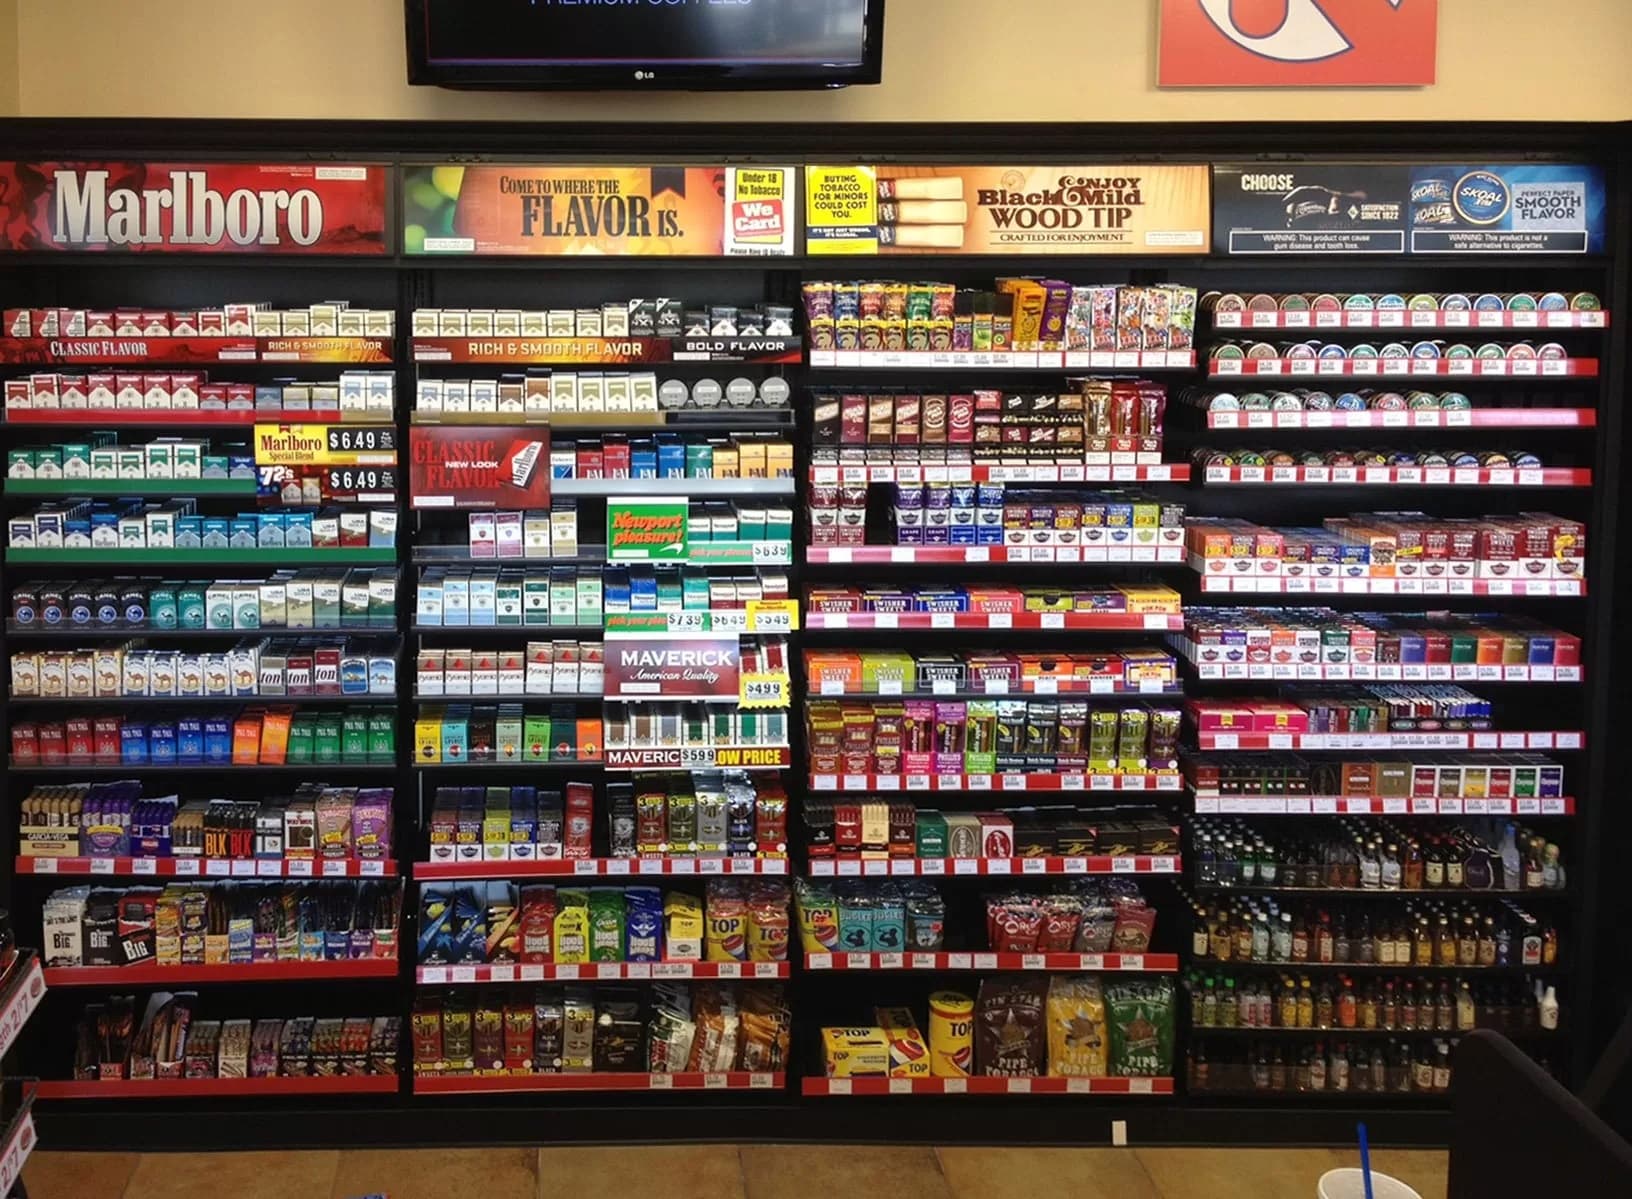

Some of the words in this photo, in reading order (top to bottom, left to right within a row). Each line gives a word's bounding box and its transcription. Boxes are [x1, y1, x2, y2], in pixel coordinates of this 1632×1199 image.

[500, 176, 533, 194] COME
[537, 180, 550, 194] TO
[551, 180, 595, 194] WHERE
[596, 180, 620, 194] THE
[742, 172, 766, 183] Under
[824, 175, 857, 183] BUYING
[1241, 174, 1294, 191] CHOOSE
[738, 184, 748, 195] No
[750, 185, 780, 196] Tobacco
[820, 183, 861, 192] TOBACCO
[1460, 187, 1502, 203] SKOAL
[813, 192, 831, 201] FOR
[834, 191, 868, 200] MINORS
[977, 188, 1059, 206] Black
[1081, 189, 1142, 206] Mild
[1515, 197, 1581, 209] SMOOTH
[53, 169, 324, 247] Marlboro
[741, 203, 774, 218] We
[814, 201, 844, 209] COULD
[846, 201, 867, 209] COST
[520, 195, 651, 237] FLAVOR
[657, 209, 684, 237] IS.
[832, 210, 852, 218] YOU.
[989, 208, 1083, 229] WOOD
[1088, 208, 1133, 229] TIP
[1361, 212, 1381, 220] SINCE
[1521, 208, 1576, 220] FLAVOR
[735, 213, 780, 232] Card
[1000, 233, 1045, 242] CRAFTED
[1046, 233, 1066, 242] FOR
[1067, 233, 1124, 242] ENJOYMENT
[1313, 234, 1337, 243] product
[1499, 234, 1523, 243] product
[50, 341, 100, 356] CLASSIC
[102, 341, 148, 356] FLAVOR
[268, 341, 290, 352] RICH
[468, 341, 504, 356] RICH
[507, 341, 519, 356] &
[521, 341, 582, 356] SMOOTH
[586, 341, 642, 356] FLAVOR
[687, 341, 724, 351] BOLD
[730, 341, 785, 351] FLAVOR
[261, 435, 322, 451] Marlboro
[329, 431, 375, 450] $6.49
[269, 452, 294, 461] Special
[295, 451, 314, 461] Blend
[413, 440, 495, 463] CLASSIC
[445, 461, 468, 469] NEW
[471, 461, 499, 469] LOOK
[260, 466, 294, 485] 72's
[331, 471, 377, 489] $6.49
[612, 511, 682, 531] Newport
[613, 530, 684, 547] pleasure!
[621, 651, 733, 667] MAVERICK
[630, 669, 679, 681] American
[682, 668, 720, 684] Quality
[743, 749, 781, 764] PRICE
[205, 832, 226, 855] BLK
[711, 919, 739, 934] TOP
[845, 1029, 870, 1037] TOP
[833, 1052, 849, 1060] TOP
[909, 1063, 928, 1073] TOP
